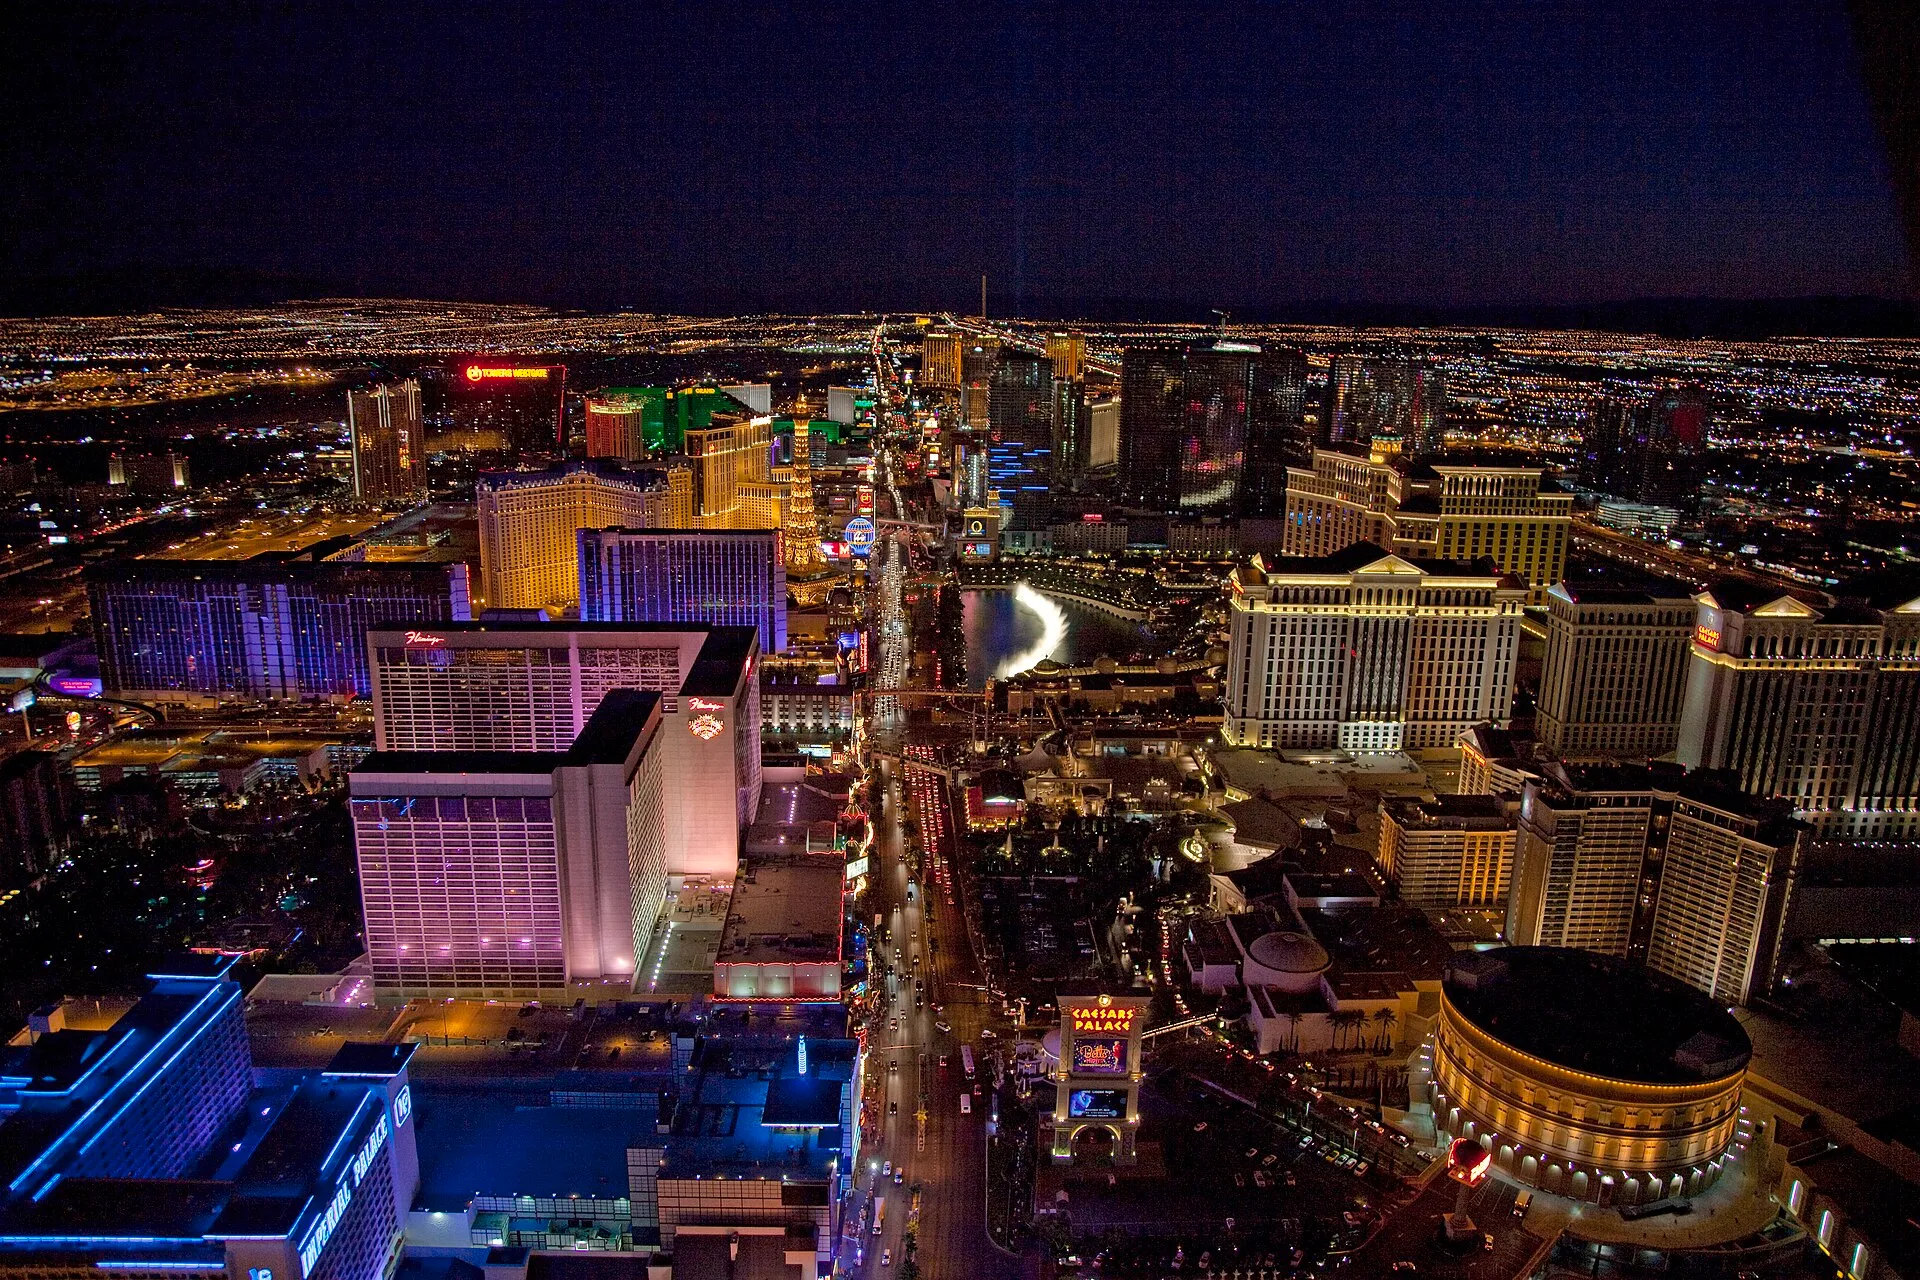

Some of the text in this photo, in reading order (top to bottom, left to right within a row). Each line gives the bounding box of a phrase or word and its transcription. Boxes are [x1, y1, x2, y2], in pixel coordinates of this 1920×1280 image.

[404, 631, 445, 646] Flamingo
[1072, 1008, 1134, 1019] CAESARS
[1075, 1020, 1130, 1031] PALACE
[300, 1113, 388, 1280] IMPERIAL PALACE
